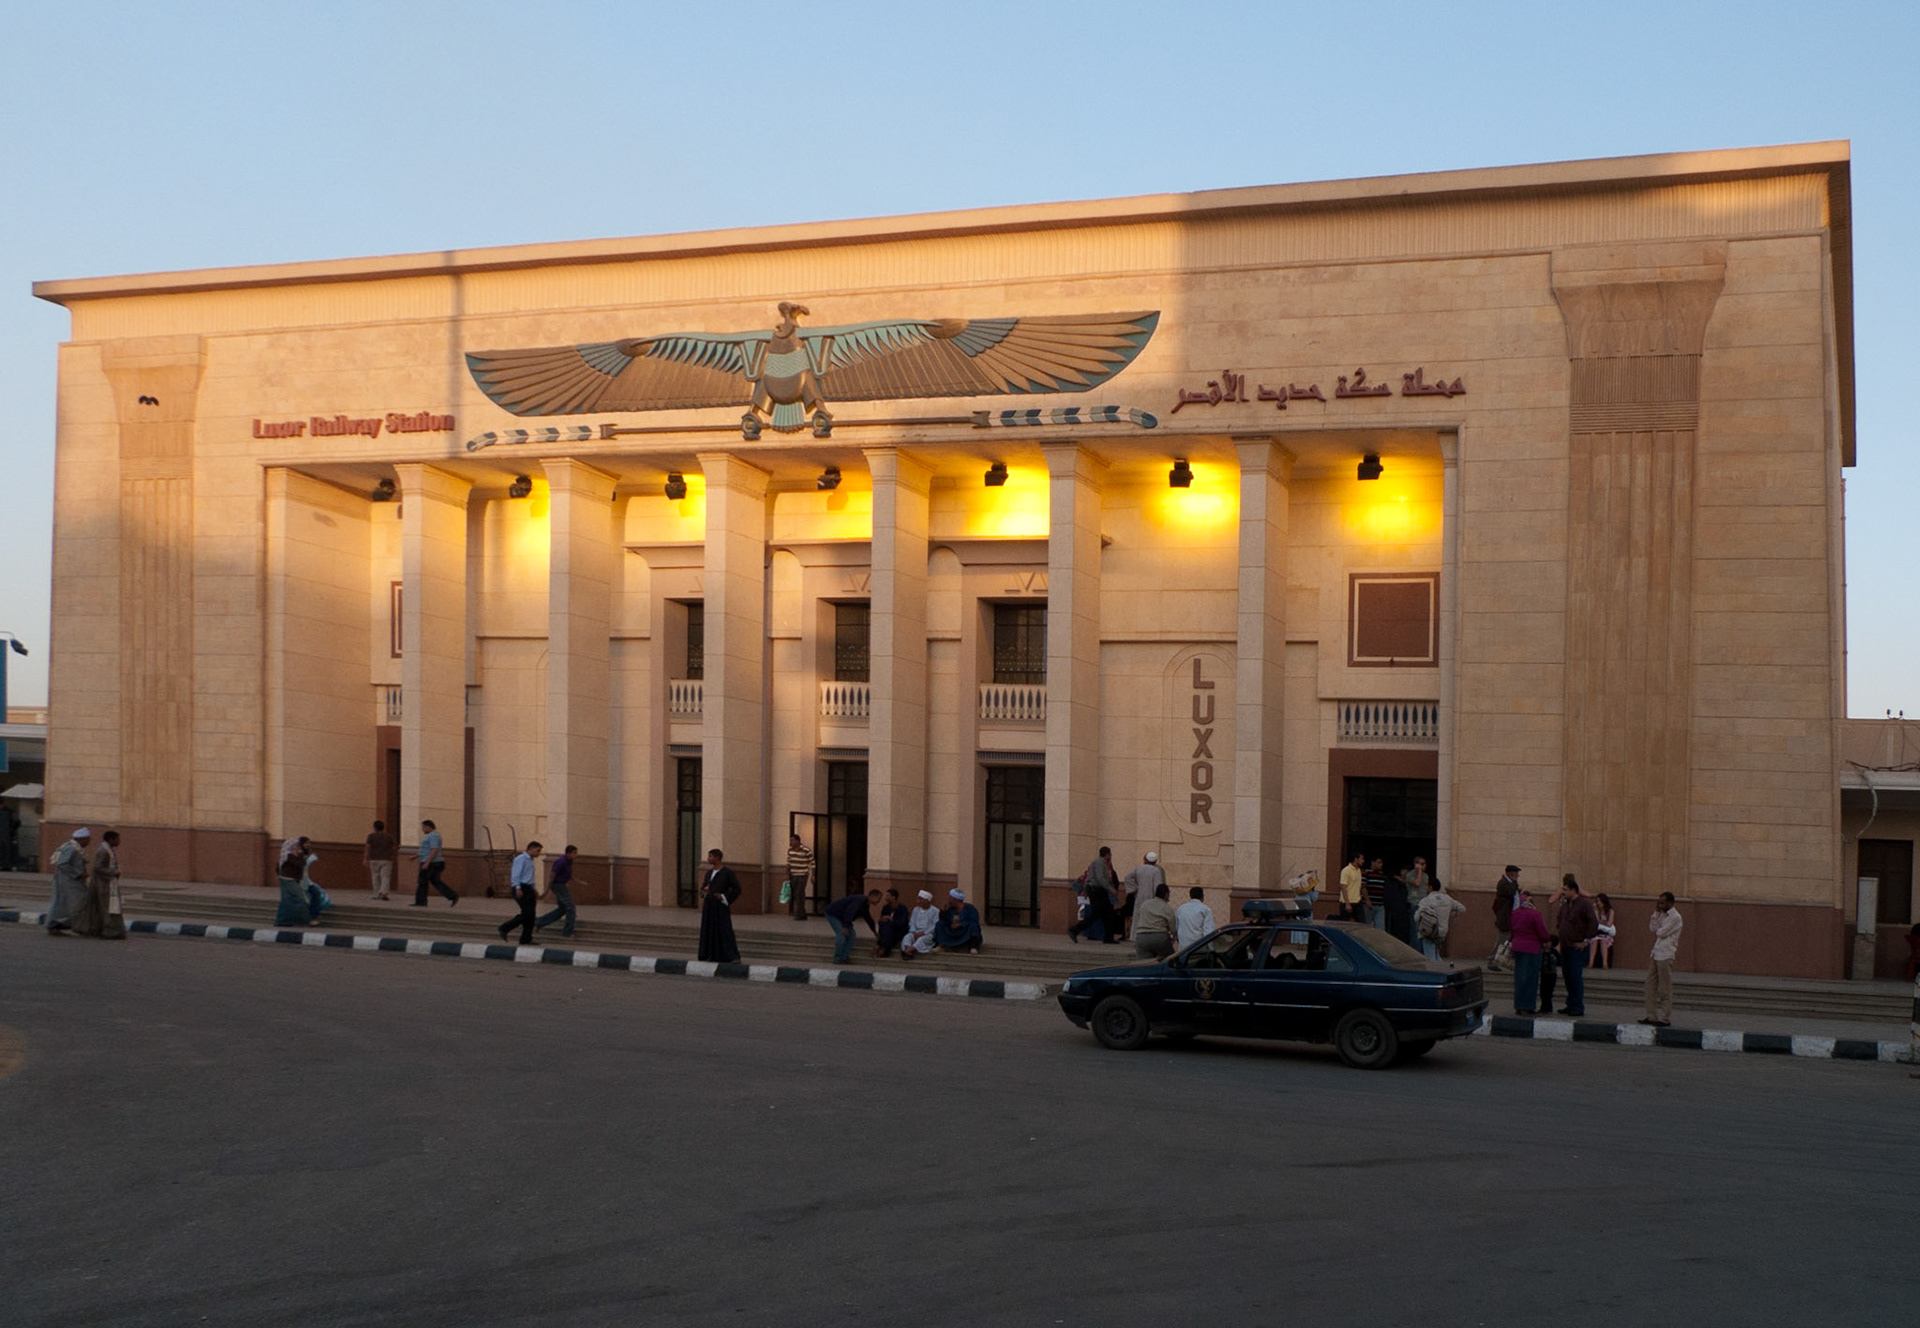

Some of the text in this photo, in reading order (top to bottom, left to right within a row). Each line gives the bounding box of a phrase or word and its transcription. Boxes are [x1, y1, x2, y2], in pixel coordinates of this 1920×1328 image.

[1170, 366, 1467, 415] محطة سكة حديد الأقصر
[252, 410, 456, 439] Luxor Railway Station
[1190, 658, 1215, 824] LUXOR
